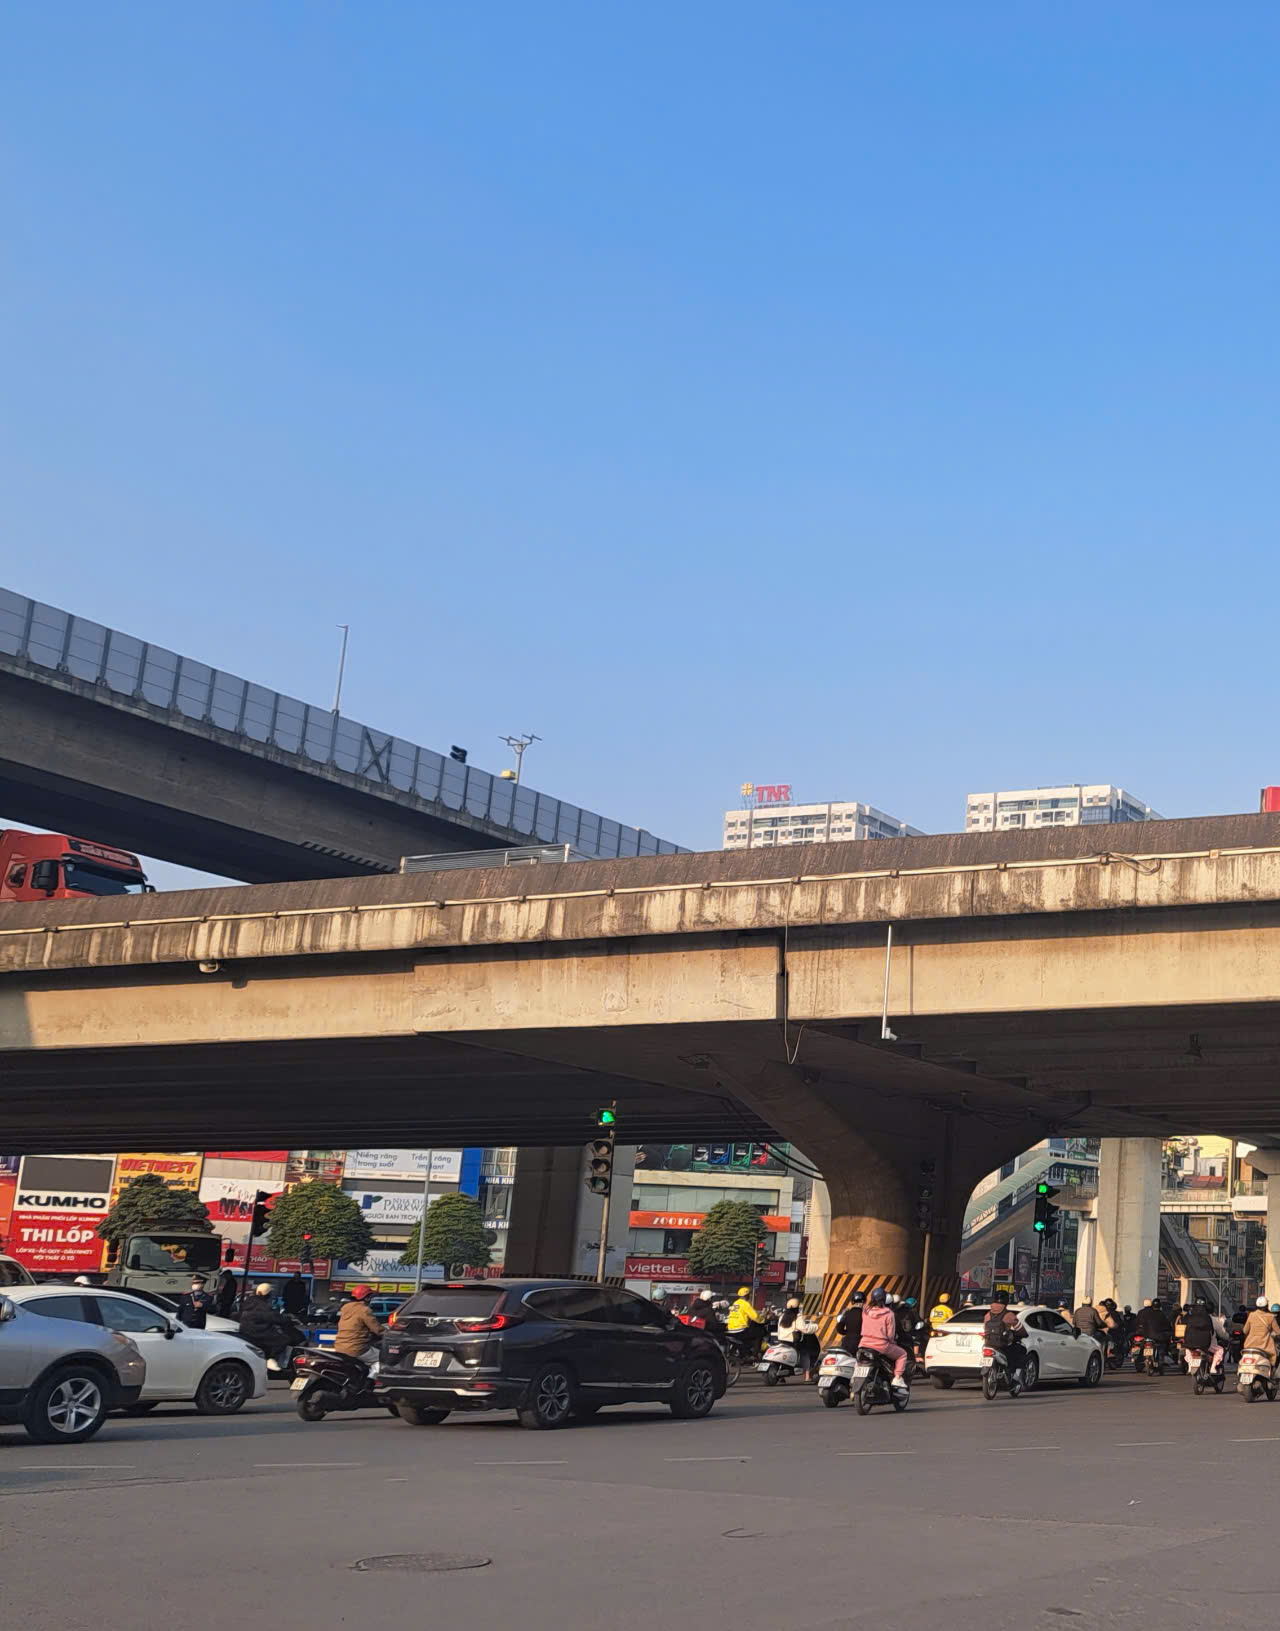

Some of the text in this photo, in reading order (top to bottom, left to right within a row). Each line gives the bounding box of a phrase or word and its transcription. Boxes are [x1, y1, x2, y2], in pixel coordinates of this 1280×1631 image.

[756, 784, 790, 802] TNR
[17, 1194, 107, 1209] KUMHO
[20, 1224, 95, 1244] THI LỐP
[628, 1263, 677, 1274] viettel
